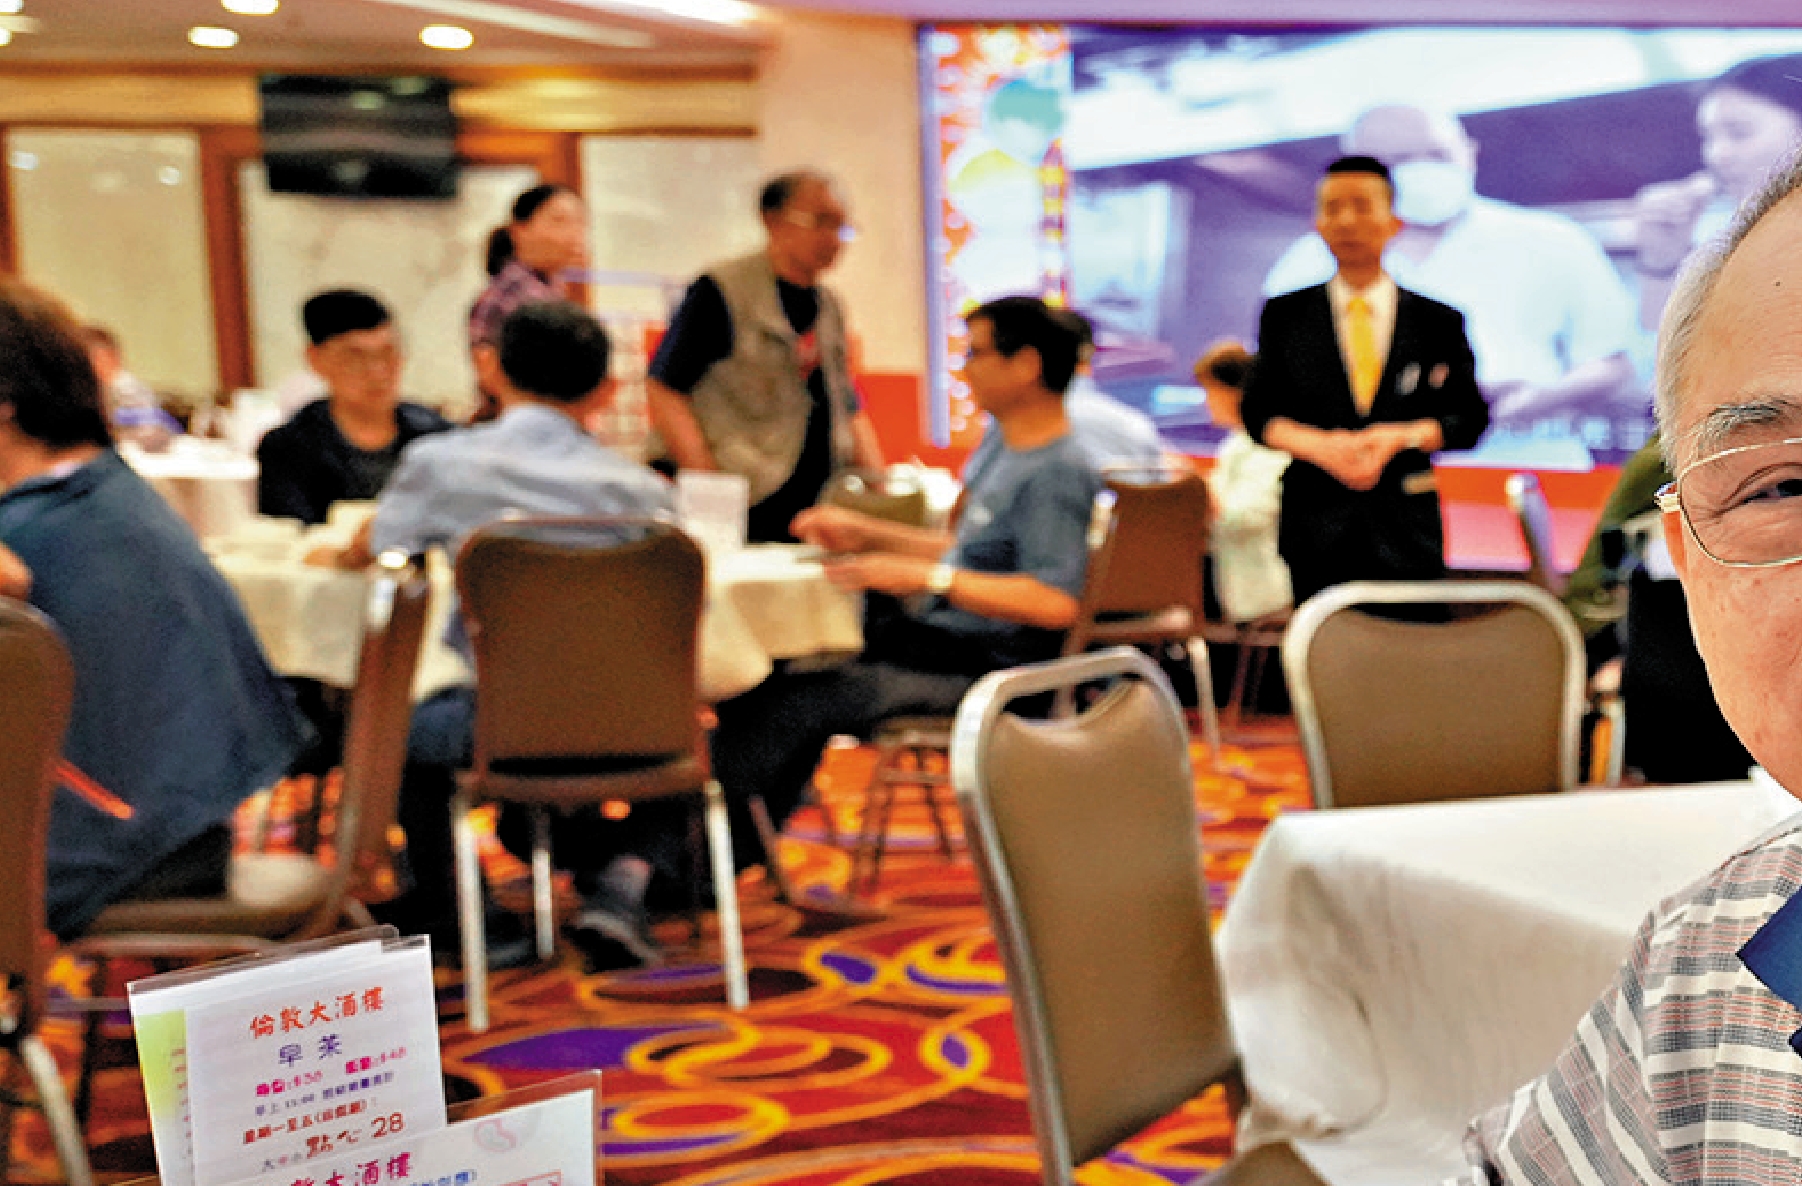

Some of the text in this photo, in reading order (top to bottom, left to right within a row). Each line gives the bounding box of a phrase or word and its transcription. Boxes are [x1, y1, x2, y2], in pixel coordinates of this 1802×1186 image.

[250, 986, 384, 1039] 倫敦大酒樓
[371, 1112, 405, 1139] 28
